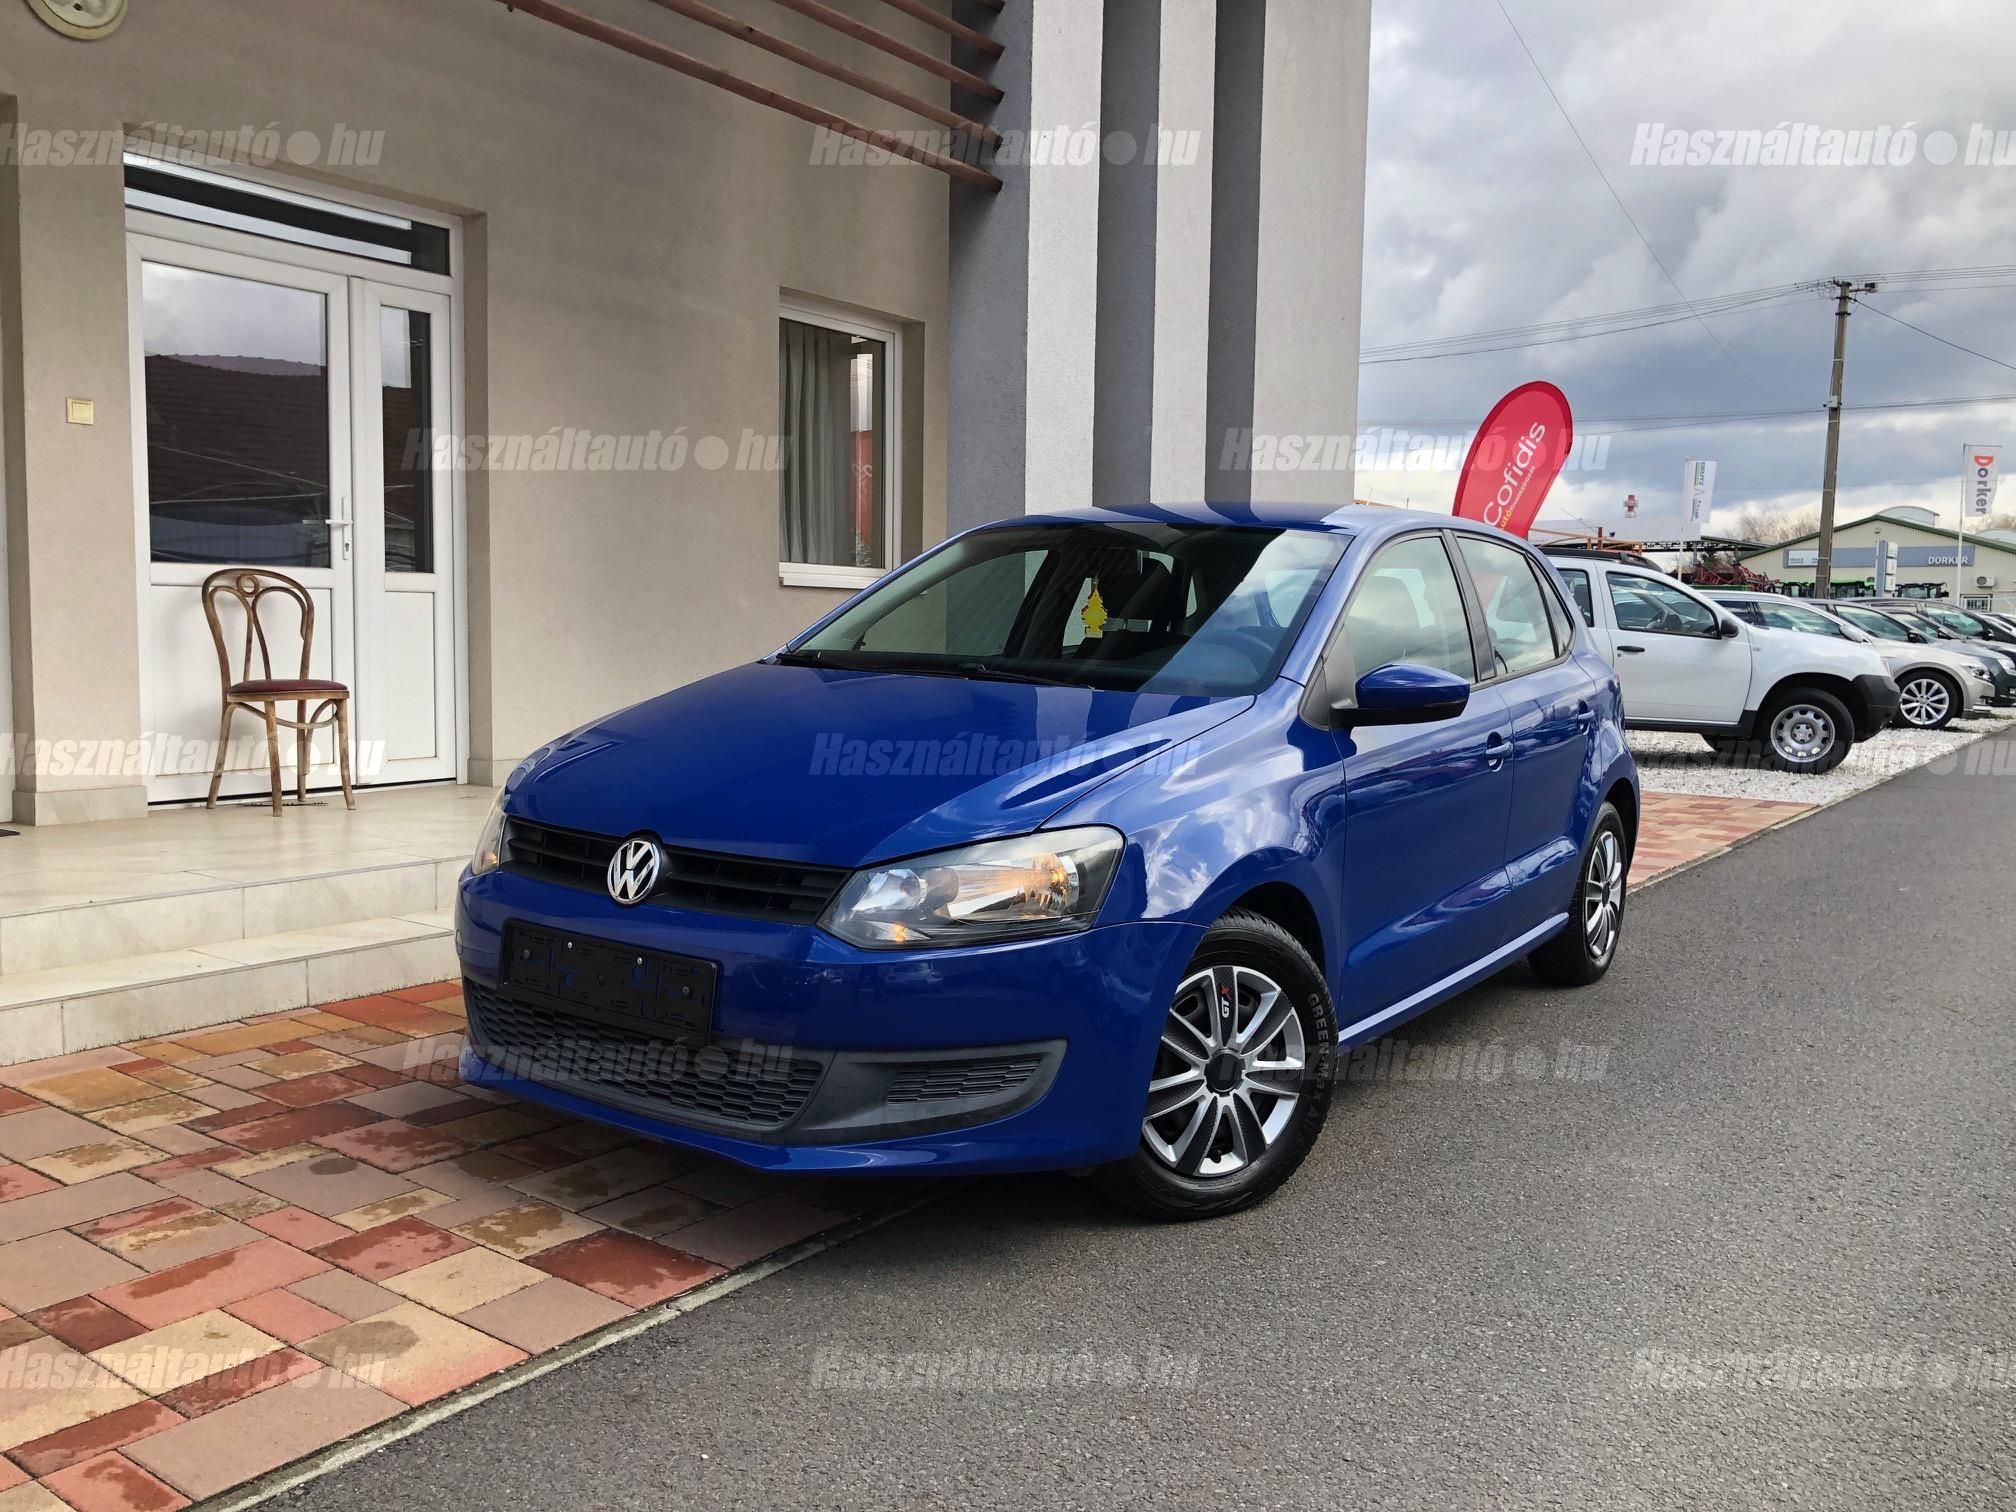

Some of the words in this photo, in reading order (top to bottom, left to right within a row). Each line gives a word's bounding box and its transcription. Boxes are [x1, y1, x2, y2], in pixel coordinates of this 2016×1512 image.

[1484, 422, 1546, 526] Cofidis
[1501, 465, 1536, 529] utófinanszírozás
[1974, 456, 1994, 514] Dorker
